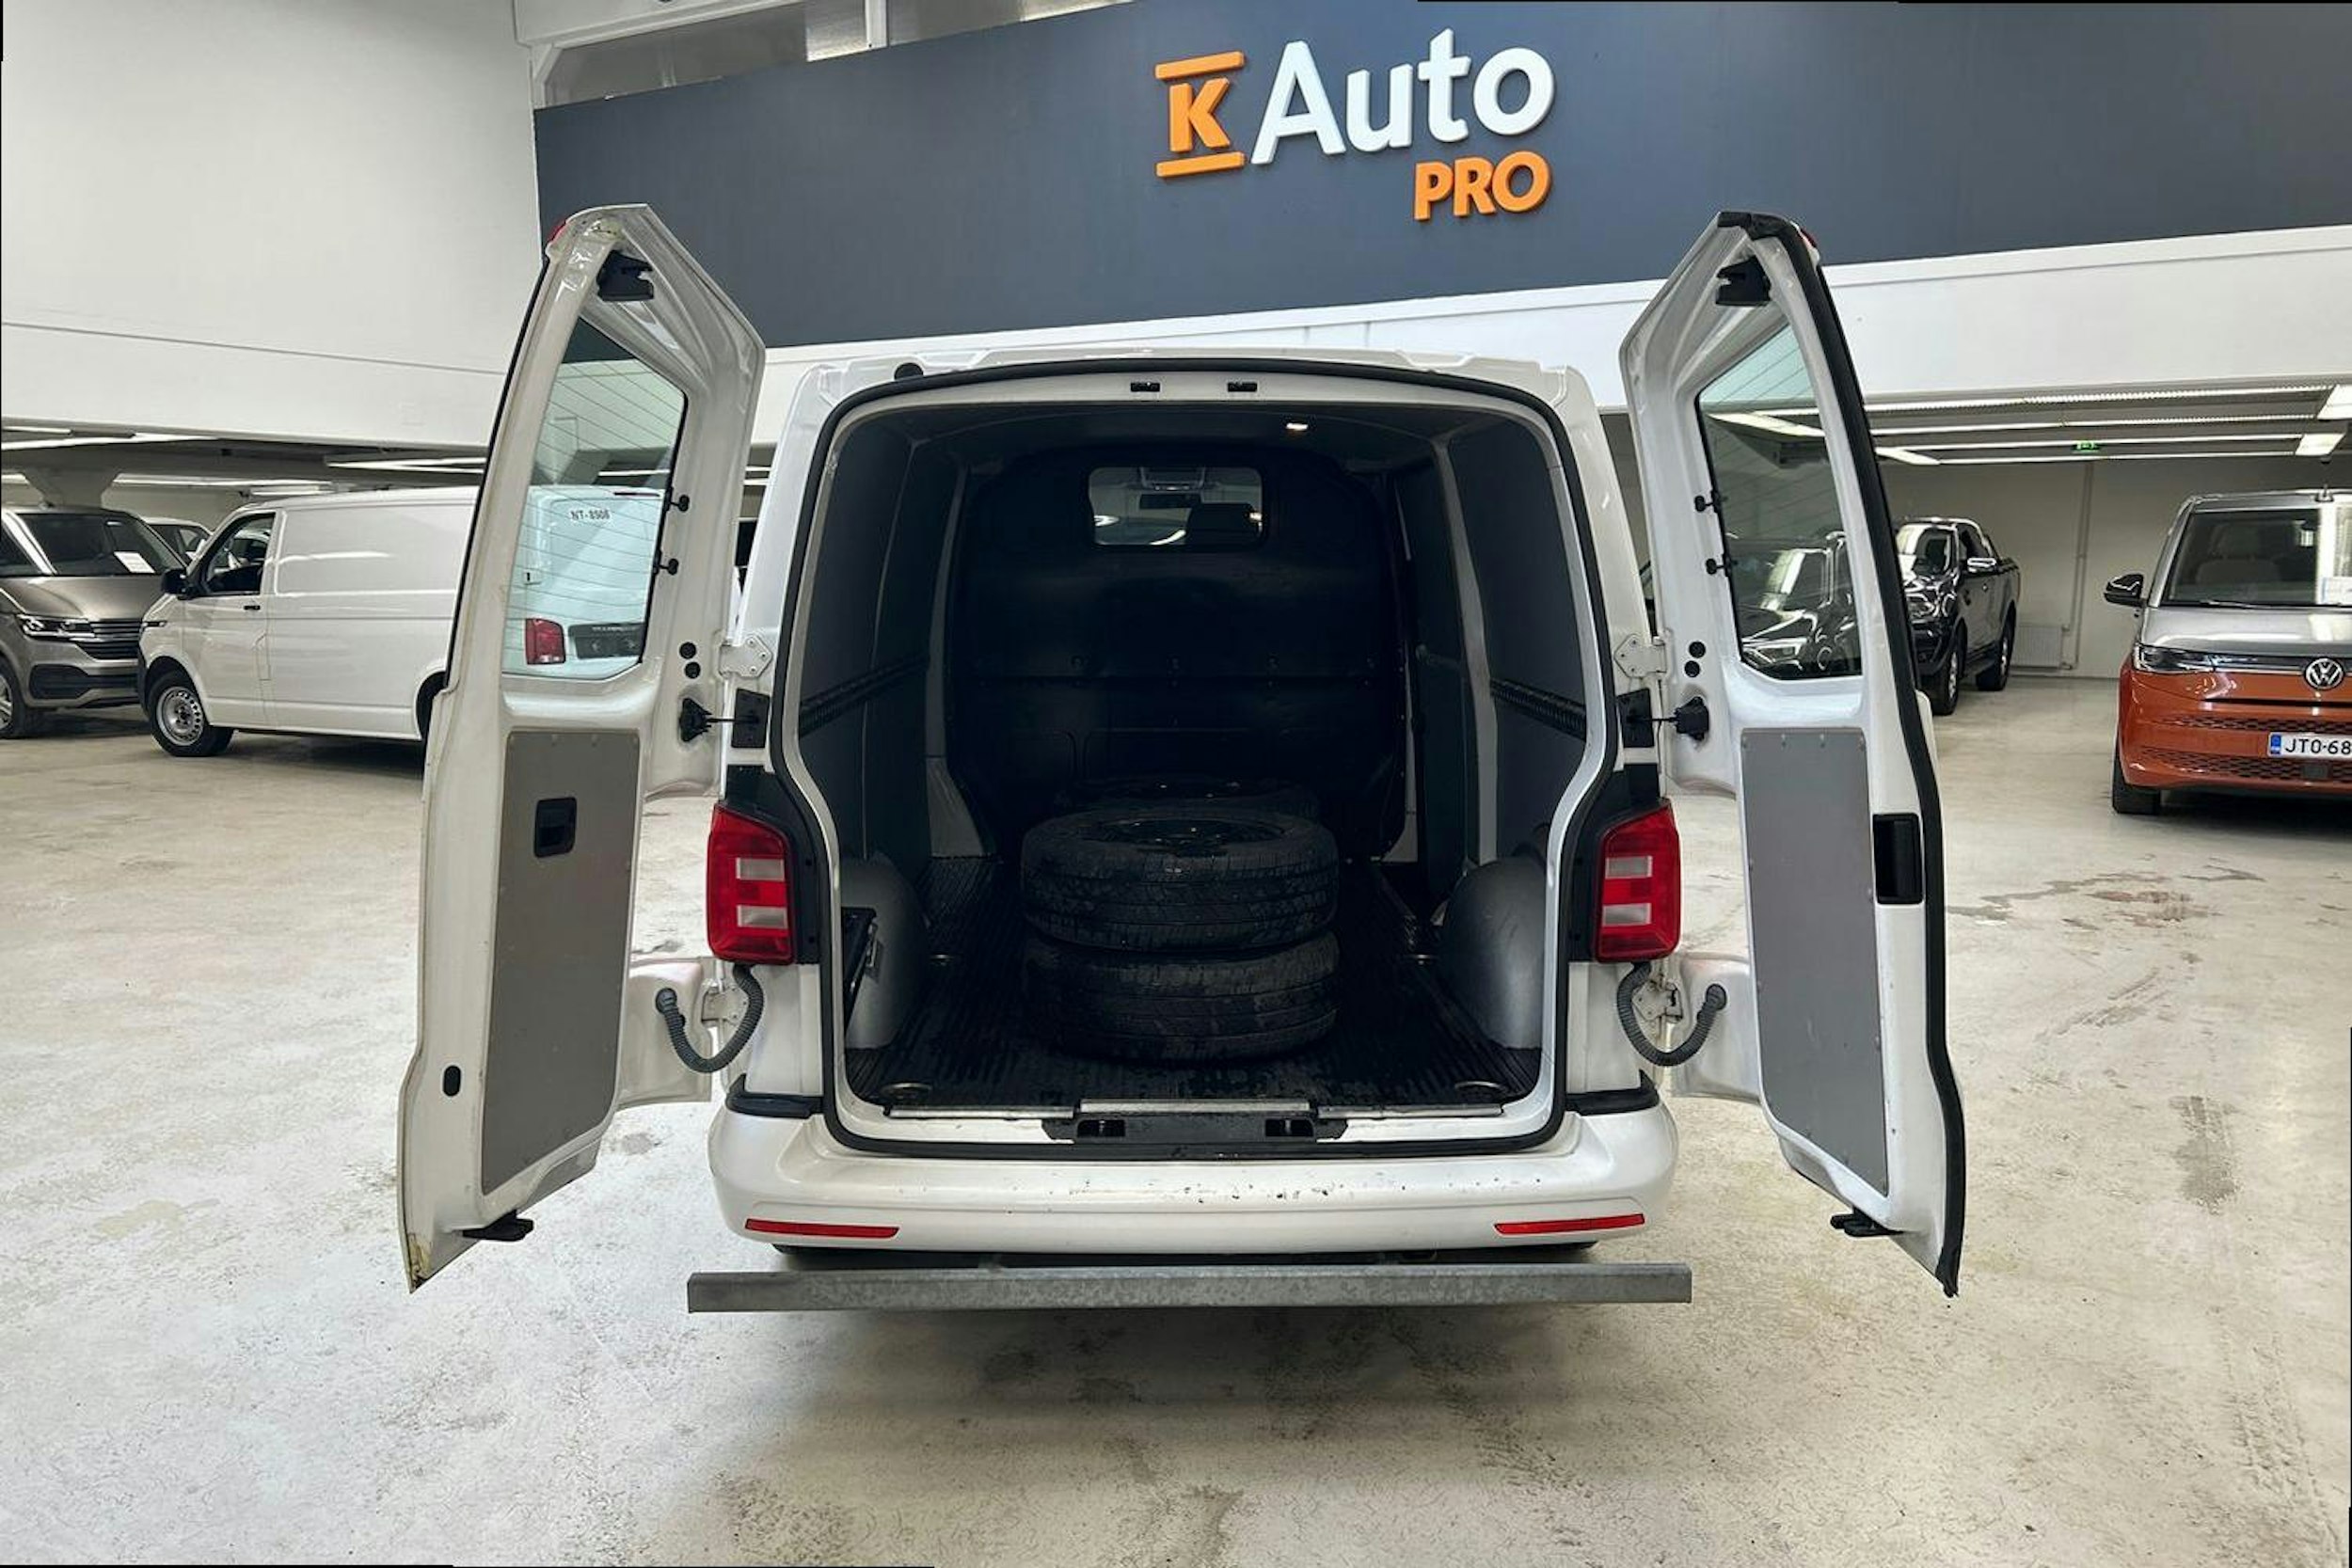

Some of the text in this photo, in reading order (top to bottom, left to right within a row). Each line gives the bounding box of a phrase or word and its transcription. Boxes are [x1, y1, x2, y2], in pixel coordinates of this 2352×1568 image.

[1169, 27, 1556, 166] K Auto
[1414, 150, 1551, 222] PRO
